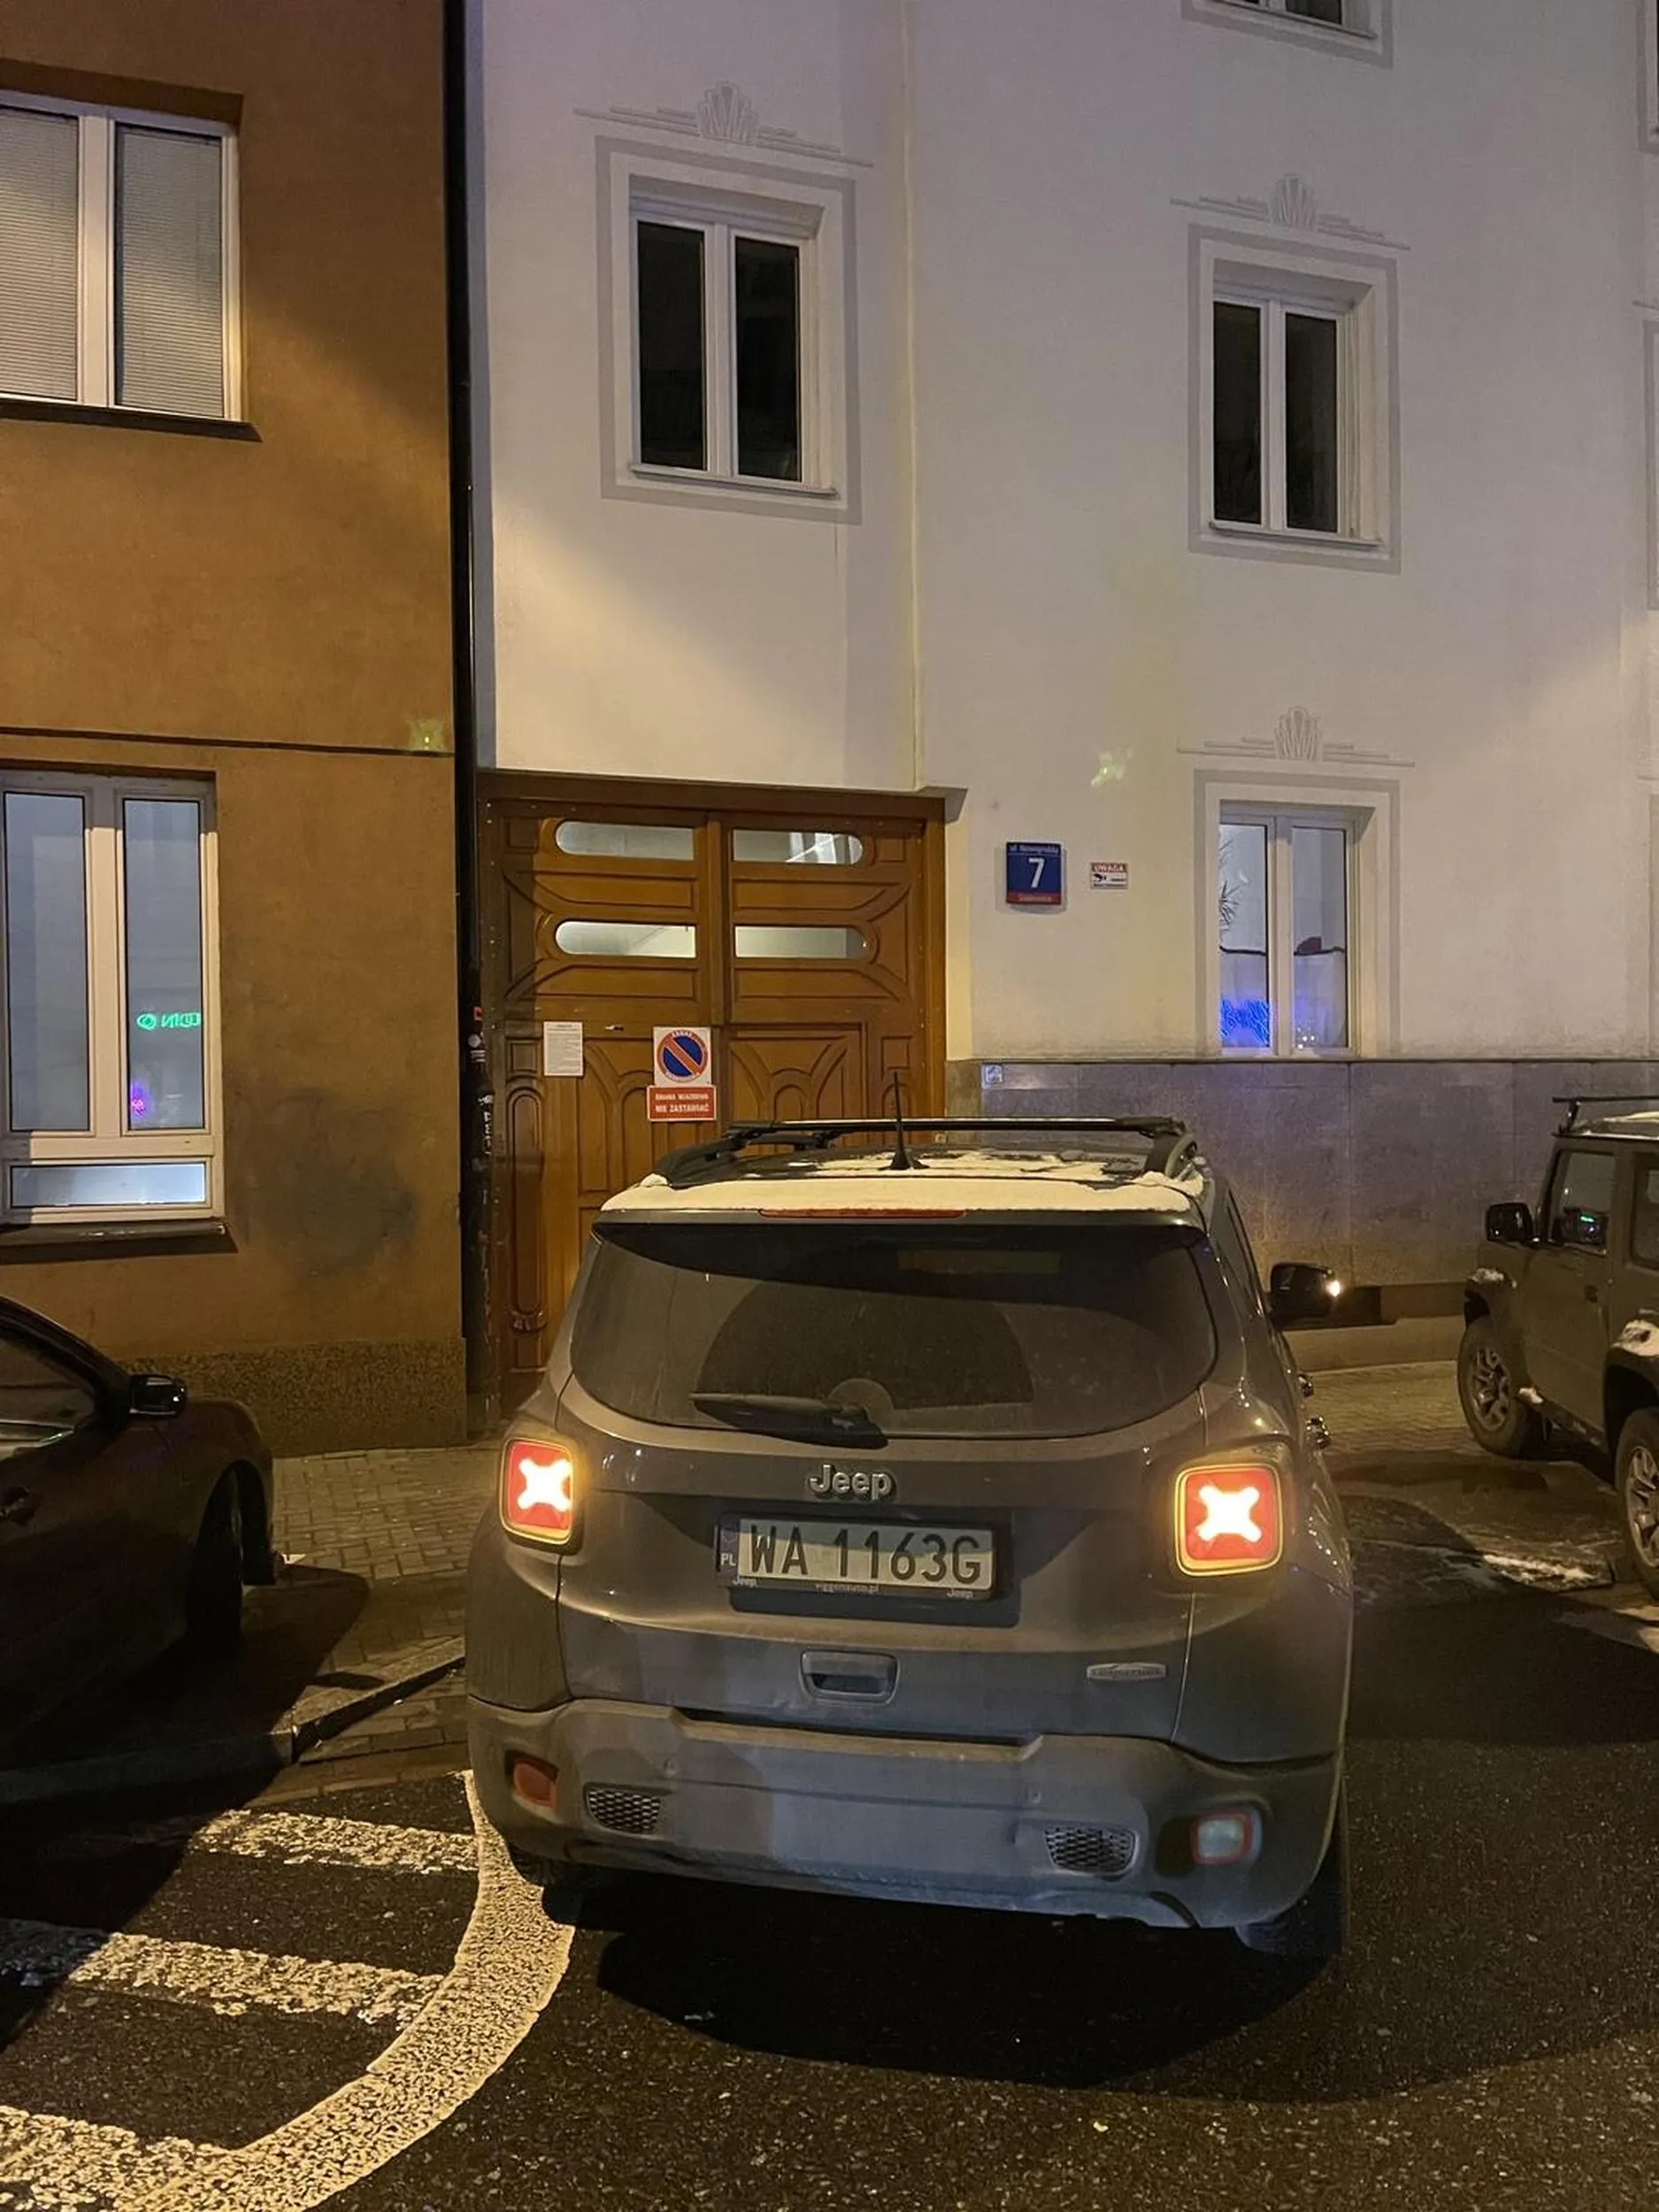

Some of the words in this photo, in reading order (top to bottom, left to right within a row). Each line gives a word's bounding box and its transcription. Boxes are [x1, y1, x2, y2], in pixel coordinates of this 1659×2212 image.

[1028, 857, 1045, 889] 7
[655, 1104, 668, 1113] NIE
[810, 1464, 892, 1501] Jeep
[721, 1553, 736, 1566] PL
[750, 1525, 808, 1575] WA
[833, 1529, 981, 1585] 1163G
[732, 1574, 757, 1588] Jeep
[946, 1587, 973, 1601] Jeep
